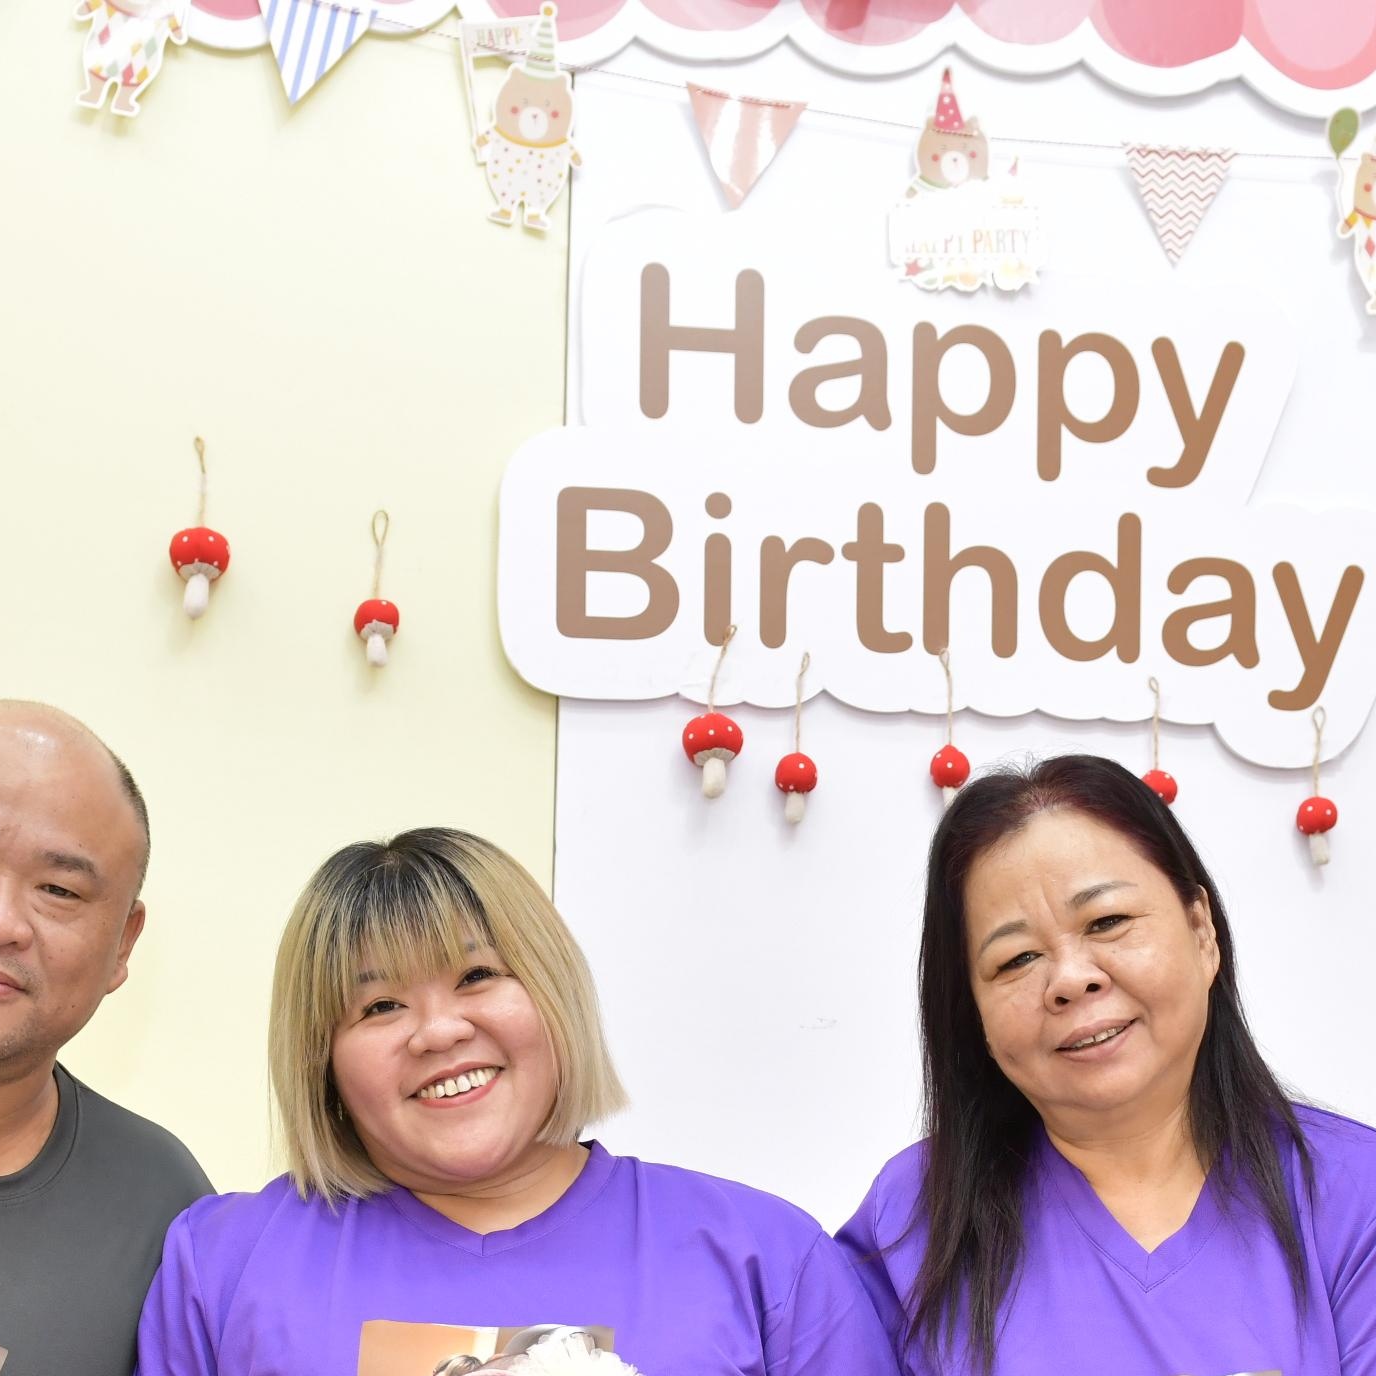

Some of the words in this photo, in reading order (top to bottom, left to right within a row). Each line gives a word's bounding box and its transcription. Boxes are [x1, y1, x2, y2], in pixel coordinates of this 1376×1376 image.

[972, 228, 1031, 254] PARTY
[638, 262, 1246, 489] Happy
[554, 485, 1366, 712] Birthday
